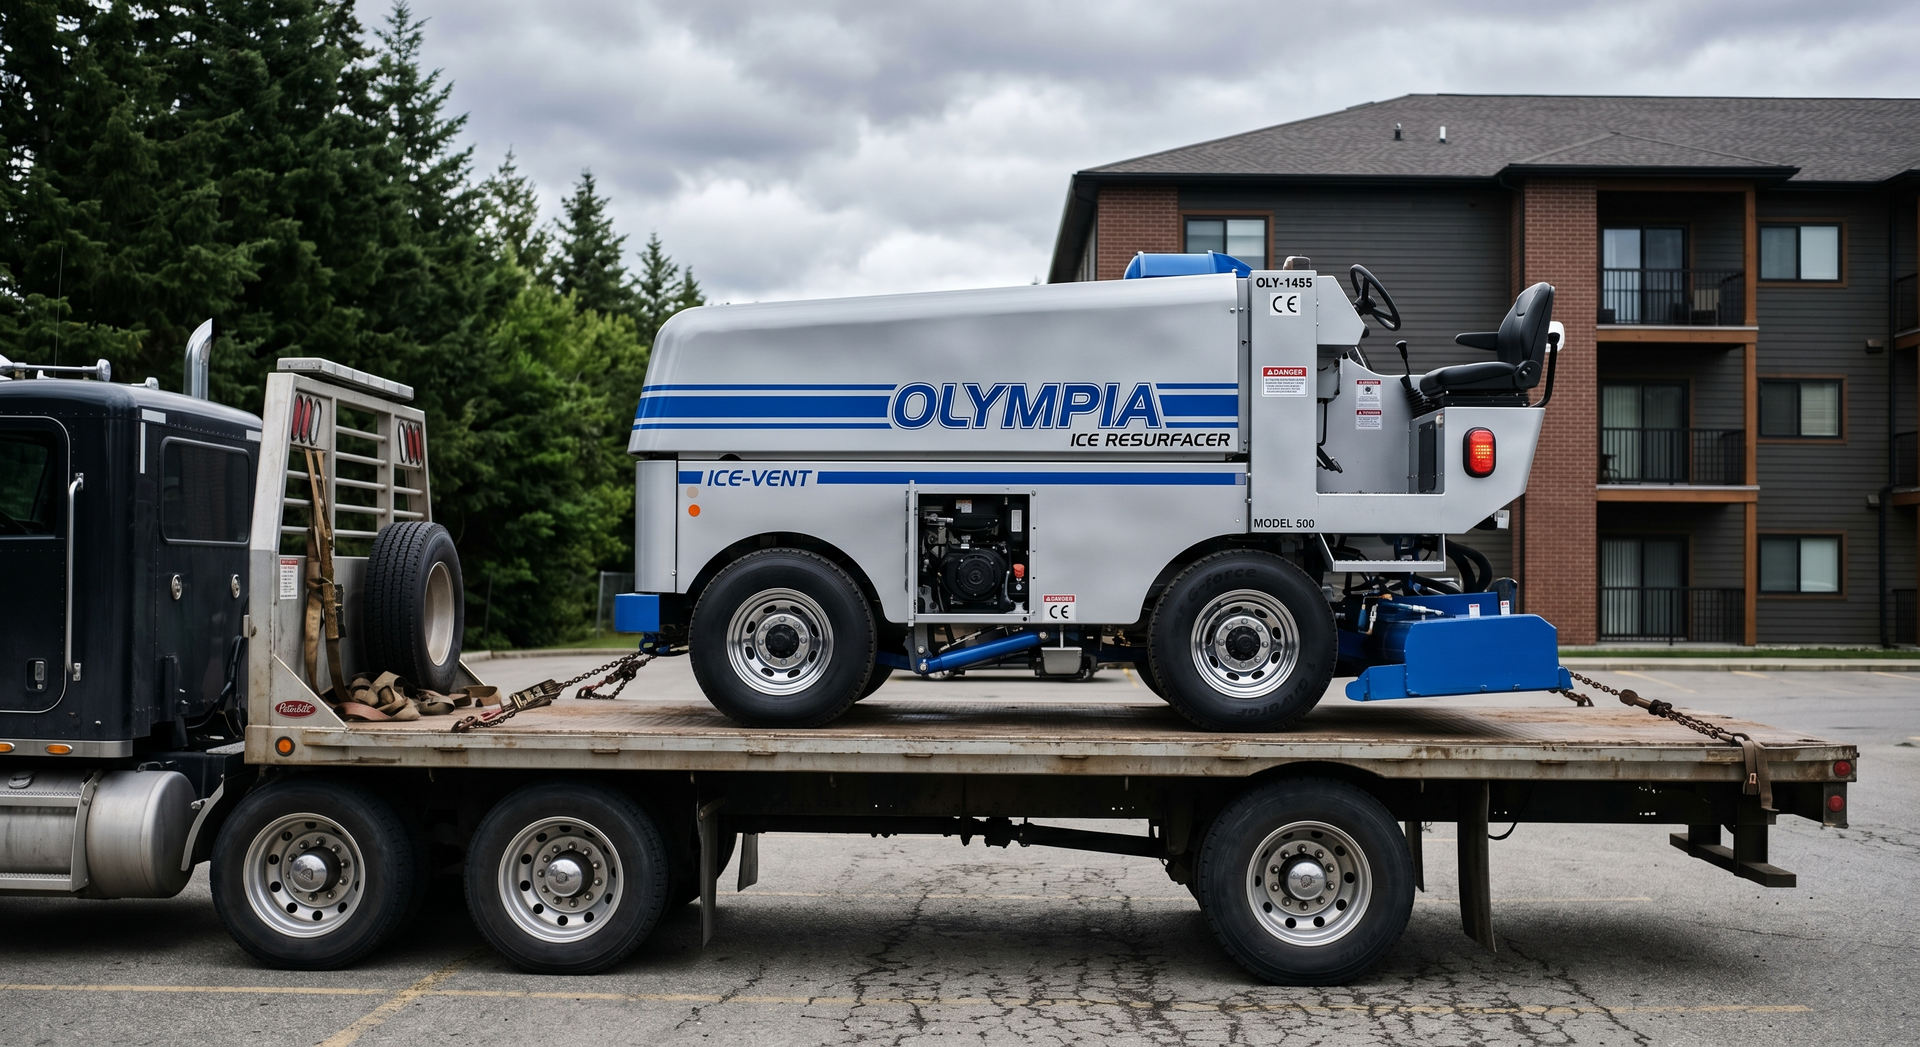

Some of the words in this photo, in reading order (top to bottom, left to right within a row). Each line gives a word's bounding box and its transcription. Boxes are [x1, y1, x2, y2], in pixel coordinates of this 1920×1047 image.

[1256, 277, 1312, 288] OLY-1455
[1272, 295, 1297, 313] CE
[892, 382, 1162, 430] OLYMPIA
[1070, 433, 1098, 447] ICE
[1105, 433, 1230, 447] RESURFACER
[707, 470, 813, 487] ICE-VENT
[1253, 518, 1293, 528] MODEL
[1296, 519, 1315, 528] 500
[1049, 605, 1069, 619] CE
